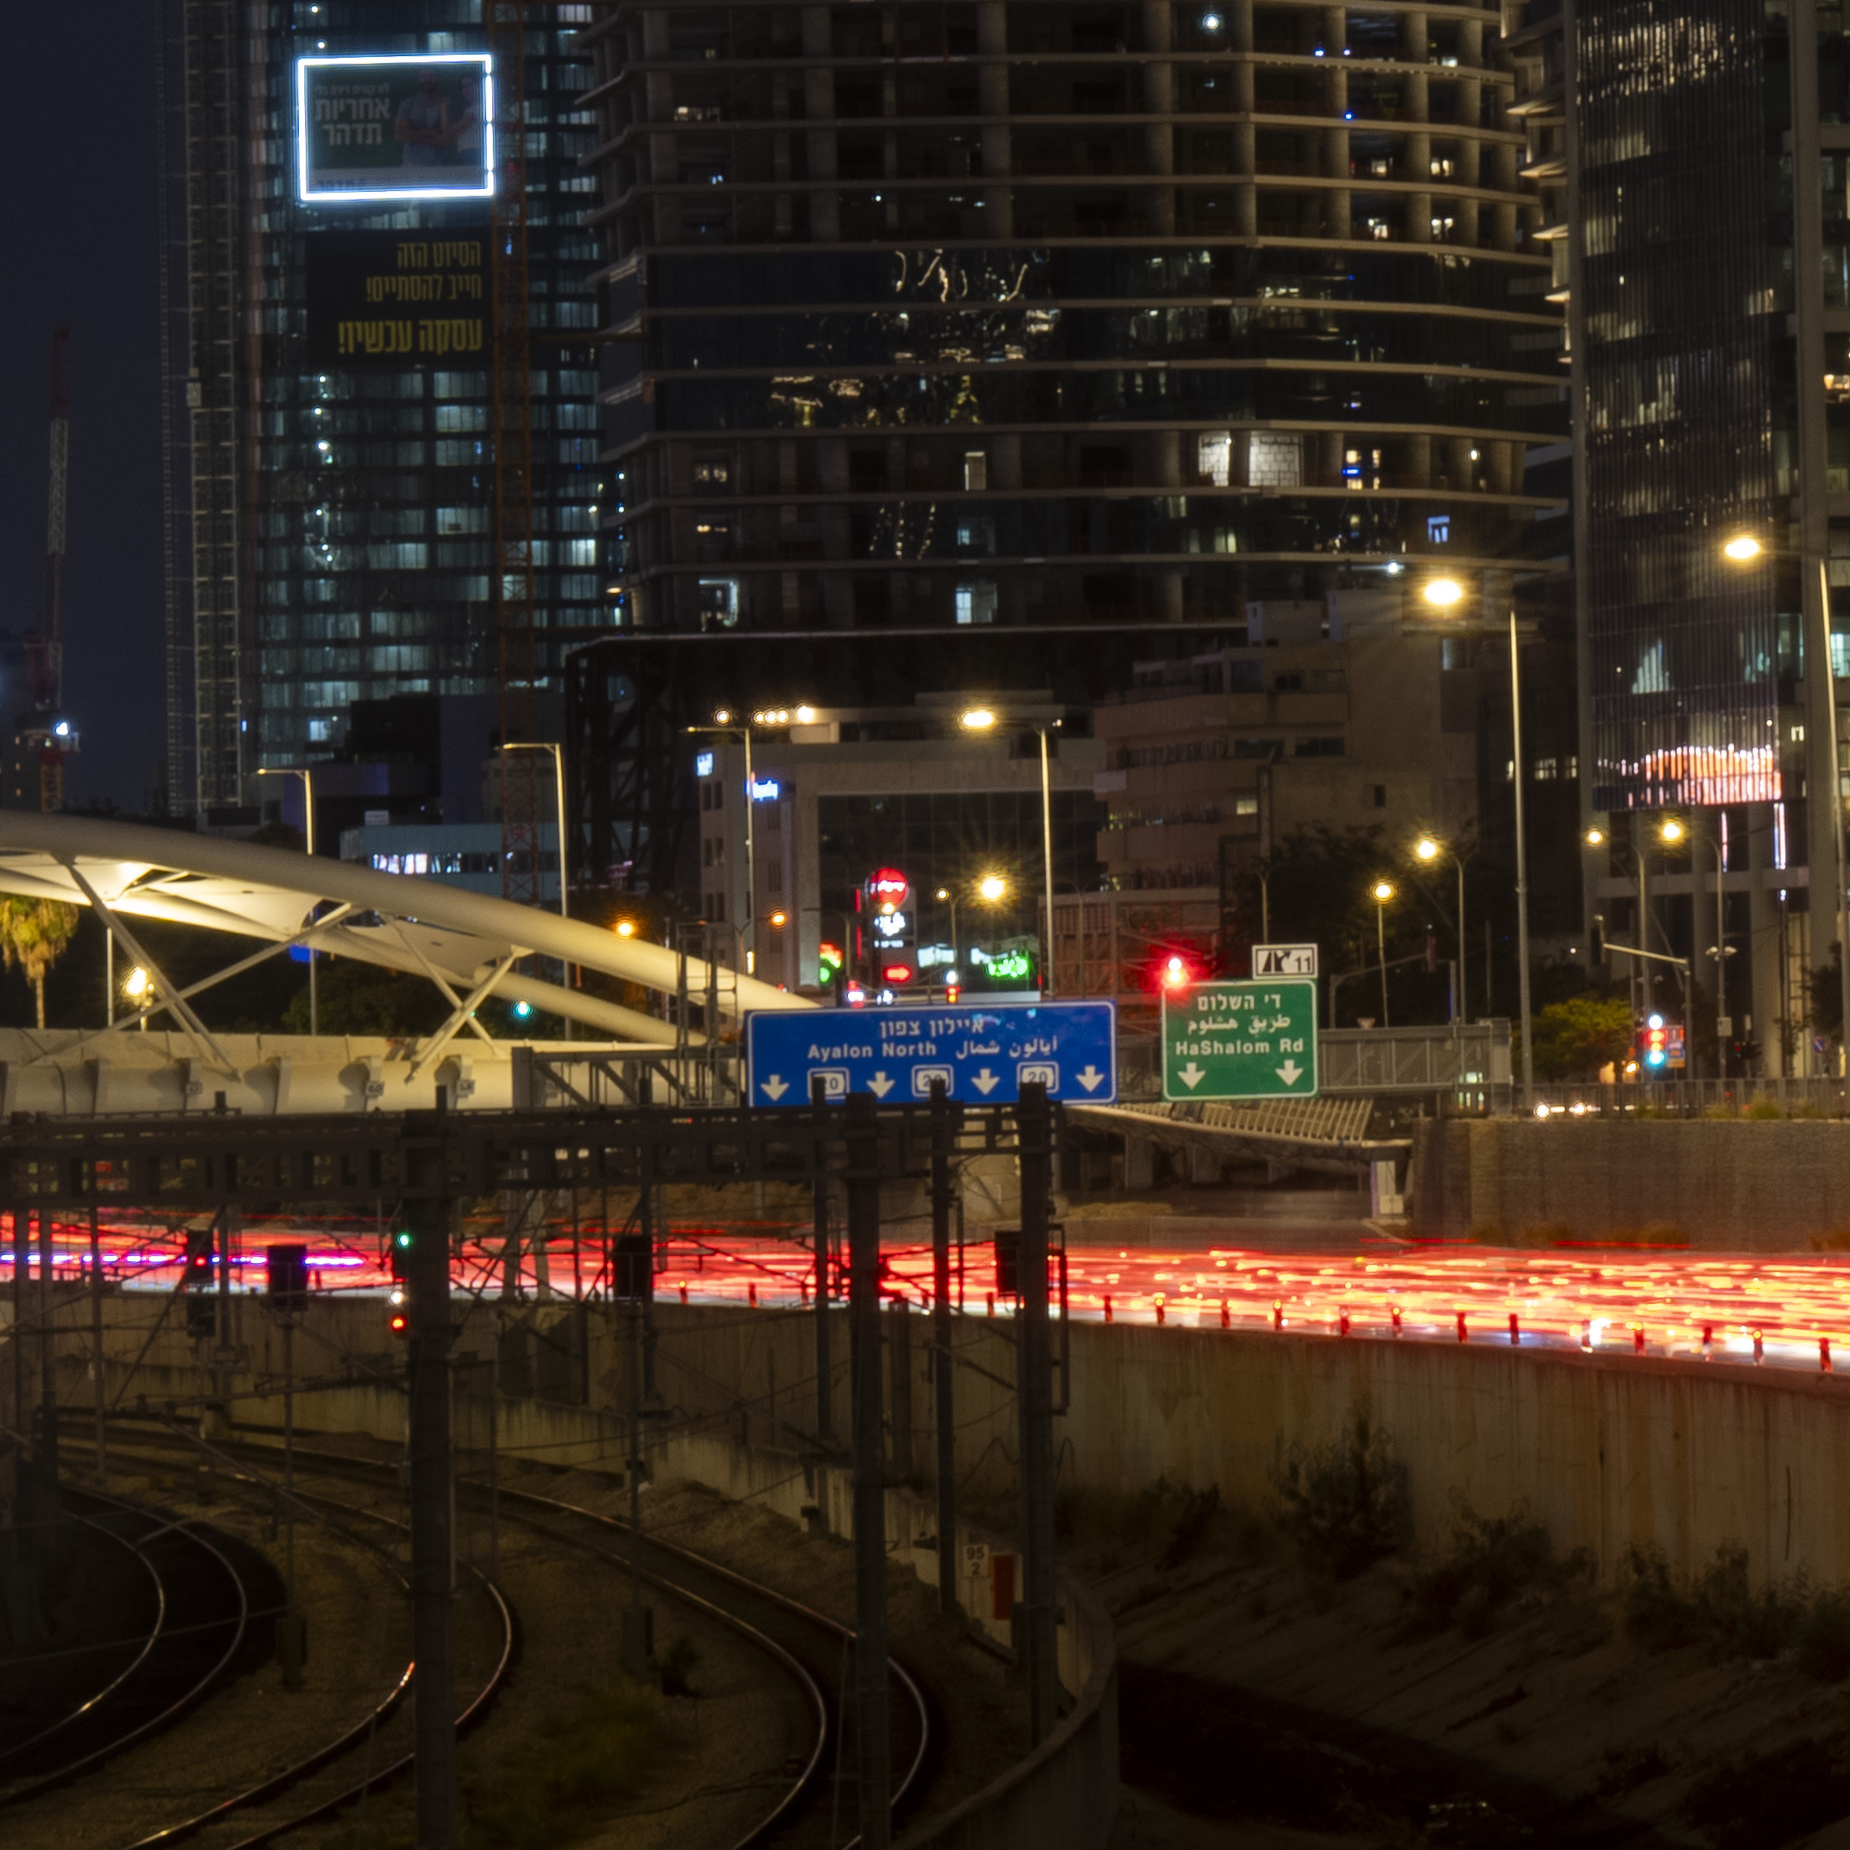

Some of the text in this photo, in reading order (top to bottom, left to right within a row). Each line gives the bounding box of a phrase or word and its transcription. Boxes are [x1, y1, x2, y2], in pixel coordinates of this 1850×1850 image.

[315, 98, 391, 121] אחריות
[322, 122, 383, 146] תדהר
[397, 241, 481, 268] הסיוט הזה
[366, 273, 482, 302] חייב להסתיים!
[338, 318, 483, 355] עסקה עכשיו!
[1294, 956, 1312, 973] 11
[1197, 993, 1256, 1012] השלום
[879, 1017, 986, 1039] איילון צפון
[807, 1040, 937, 1062] Ayalon North
[1175, 1037, 1304, 1056] HaShalom Rd
[966, 1546, 985, 1561] 95
[971, 1562, 981, 1576] 2
